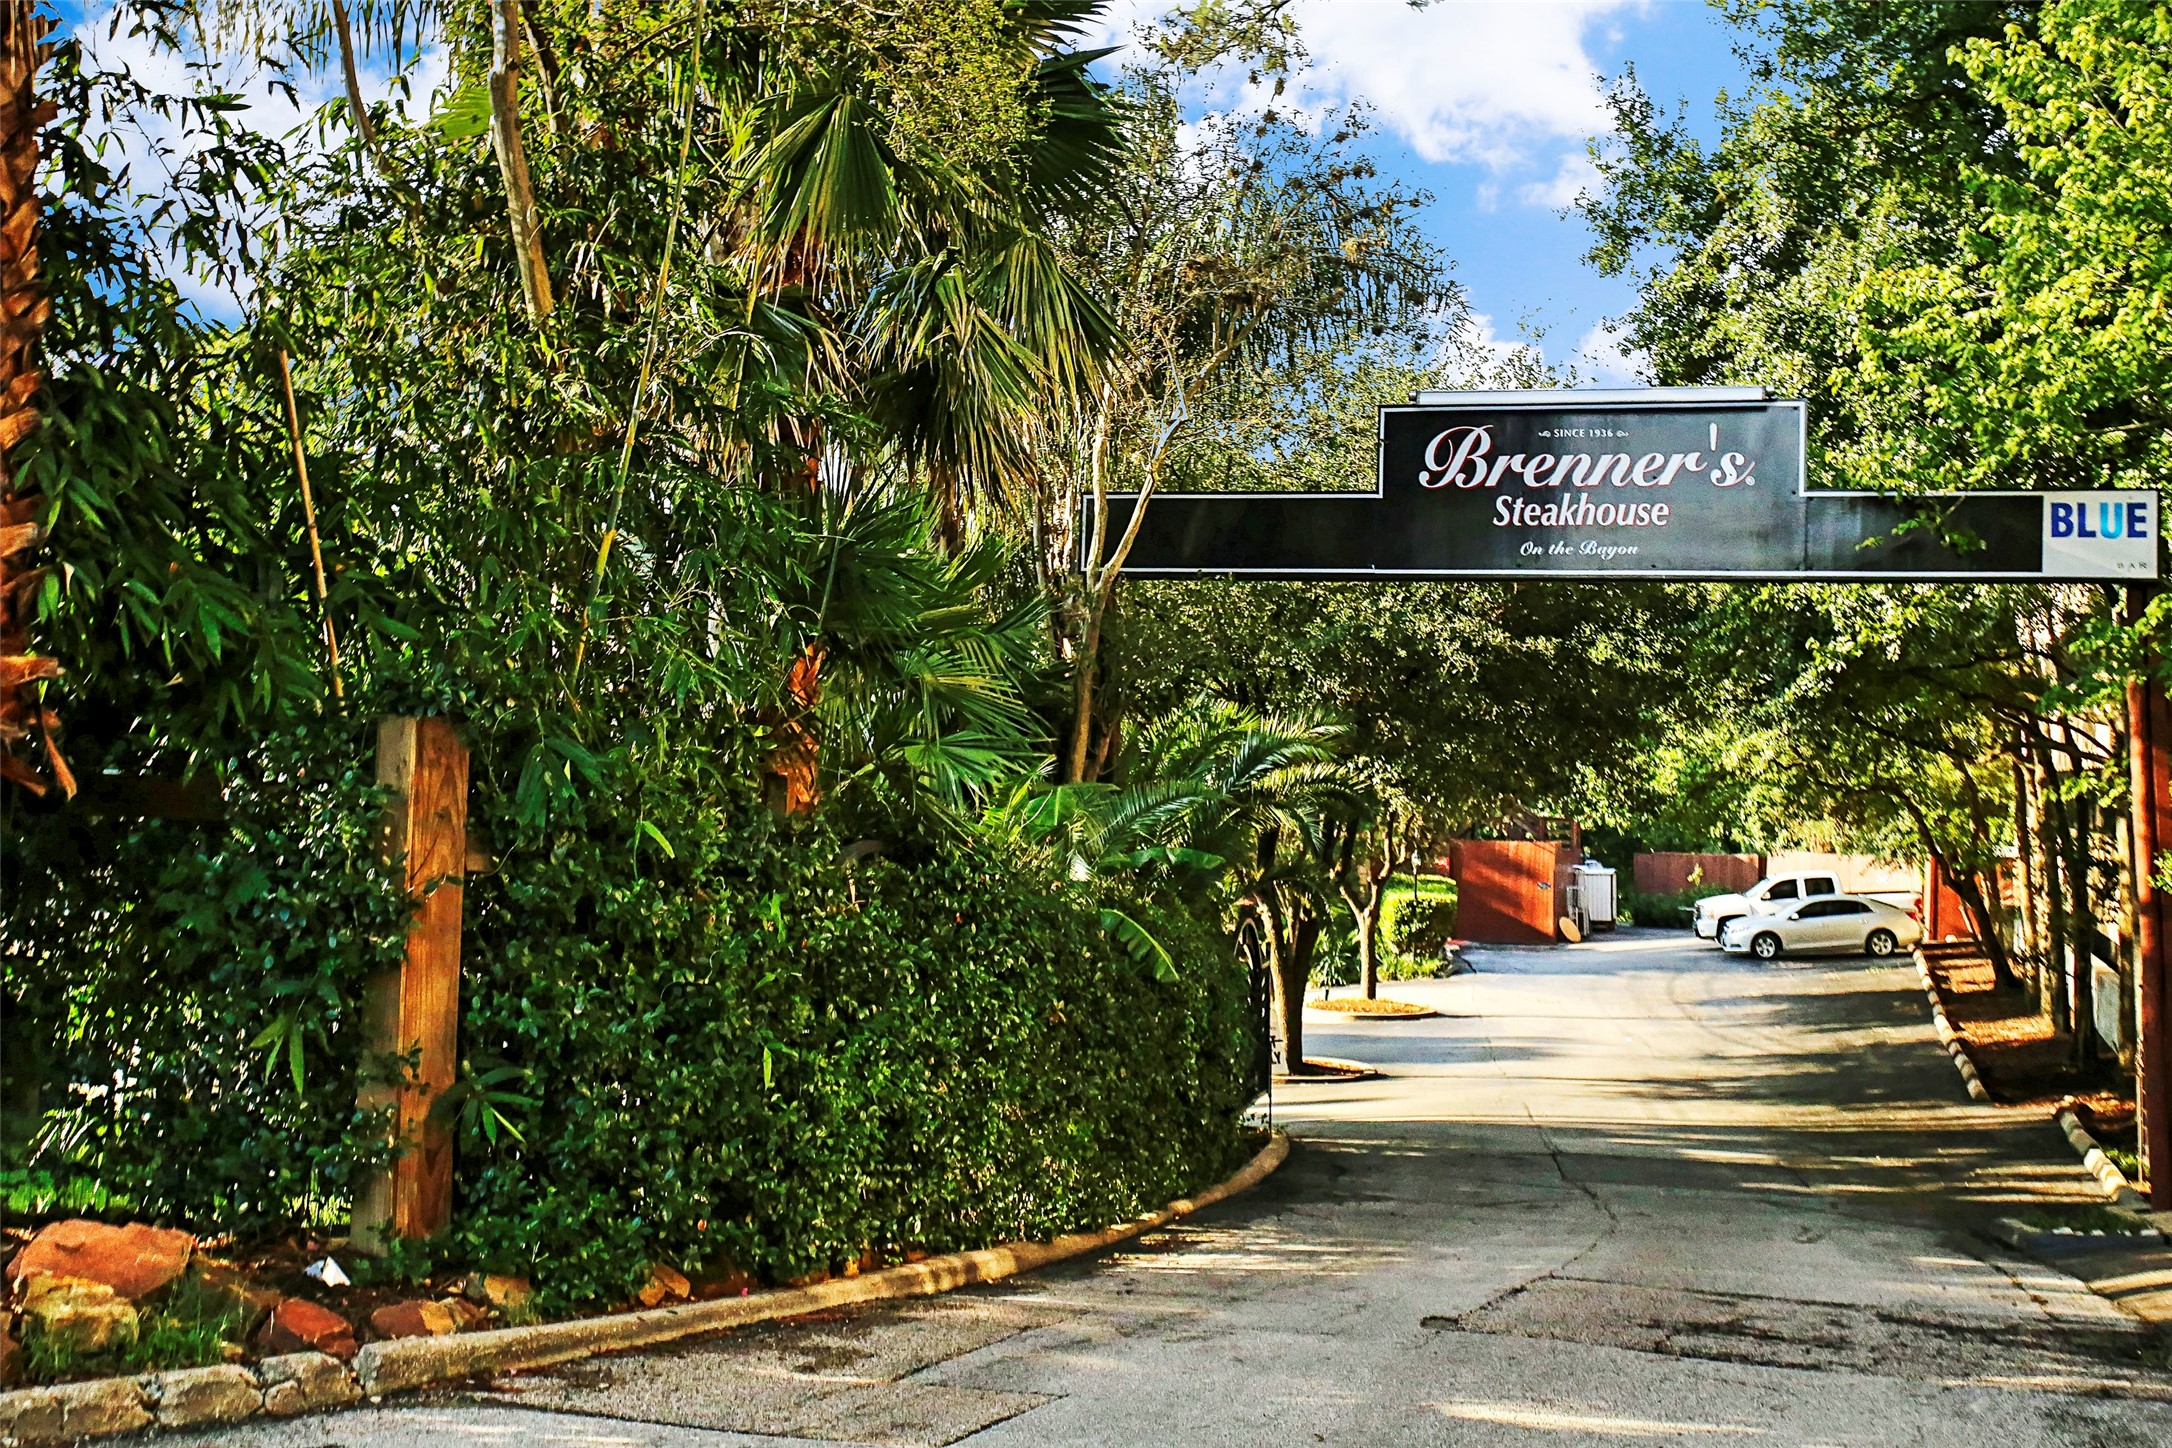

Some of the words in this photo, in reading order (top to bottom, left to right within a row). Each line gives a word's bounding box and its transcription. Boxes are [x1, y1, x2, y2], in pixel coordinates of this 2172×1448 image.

[1553, 429, 1585, 438] SINCE
[1589, 429, 1613, 438] 1936
[1418, 422, 1755, 490] Brenner's
[1493, 492, 1670, 527] Steakhouse
[2050, 502, 2148, 539] BLUE
[1520, 541, 1543, 556] On
[1548, 540, 1574, 555] the
[1579, 540, 1639, 560] Bayou
